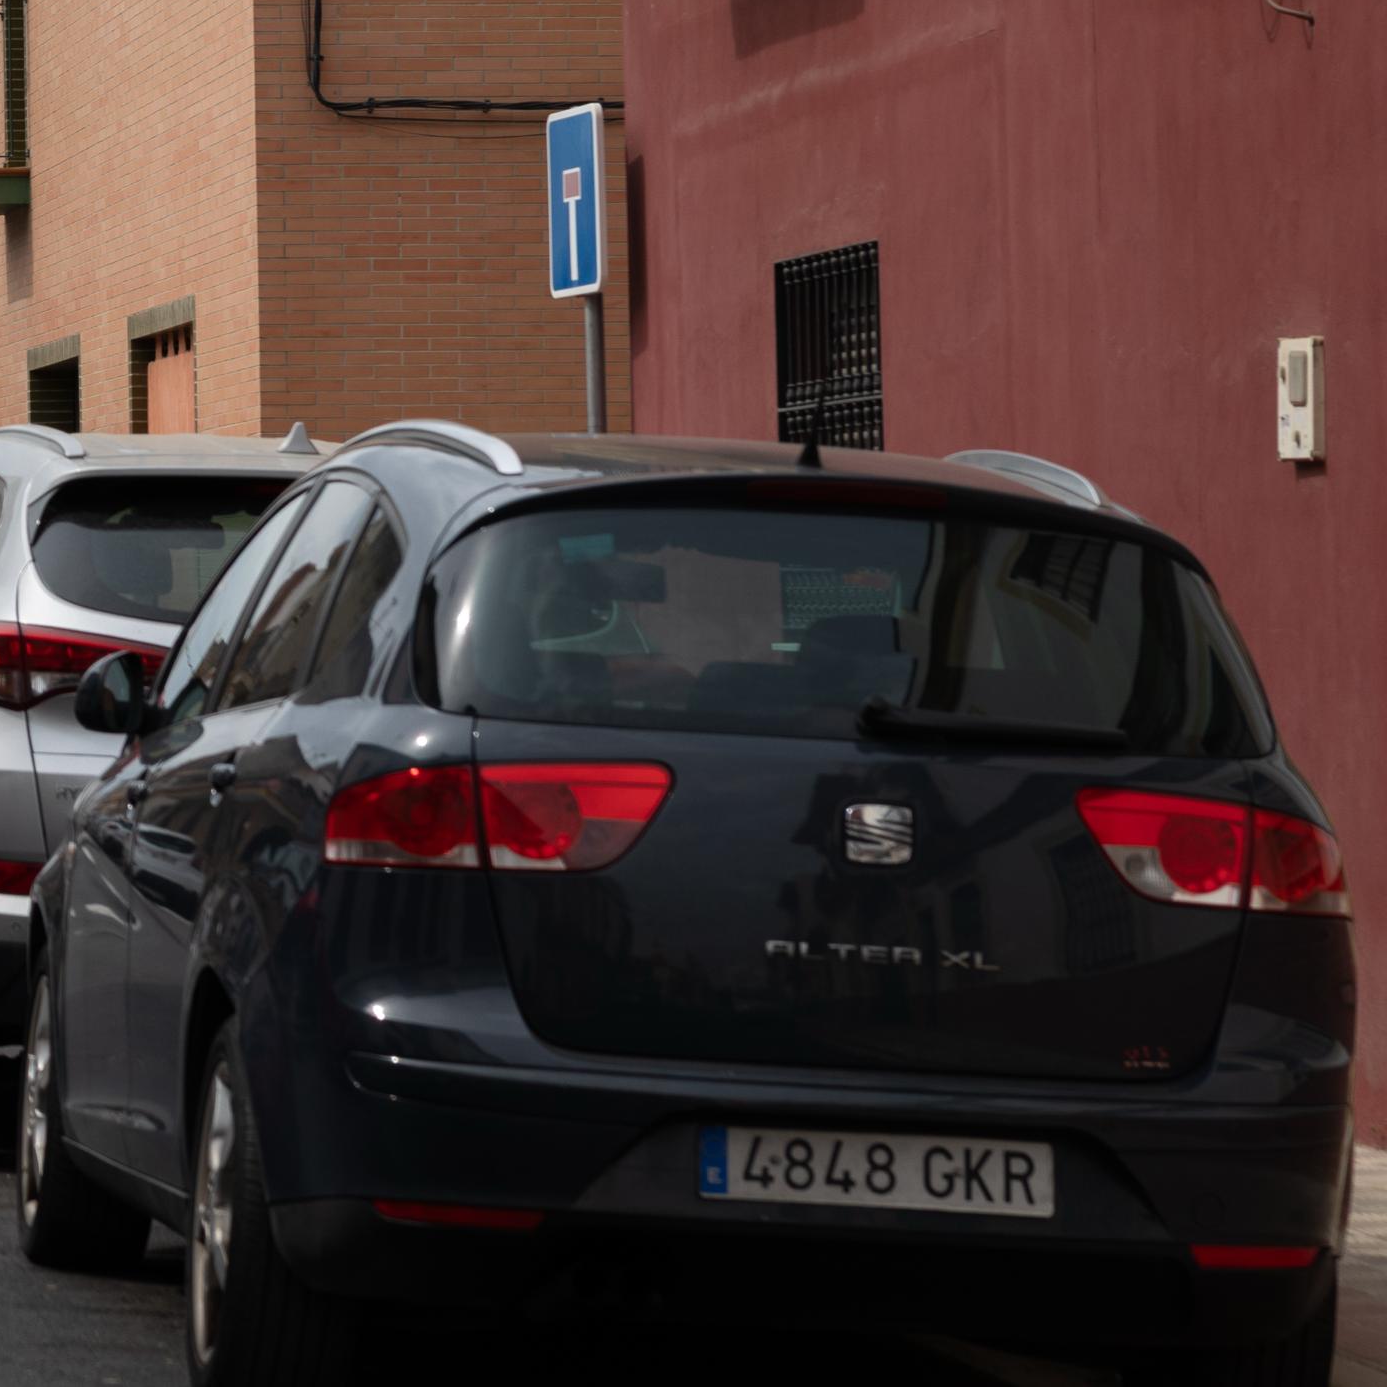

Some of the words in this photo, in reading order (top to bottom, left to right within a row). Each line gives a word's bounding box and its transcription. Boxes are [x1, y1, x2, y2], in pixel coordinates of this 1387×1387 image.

[940, 949, 1002, 972] XL
[742, 1135, 896, 1196] 4848
[924, 1145, 1036, 1206] GKR
